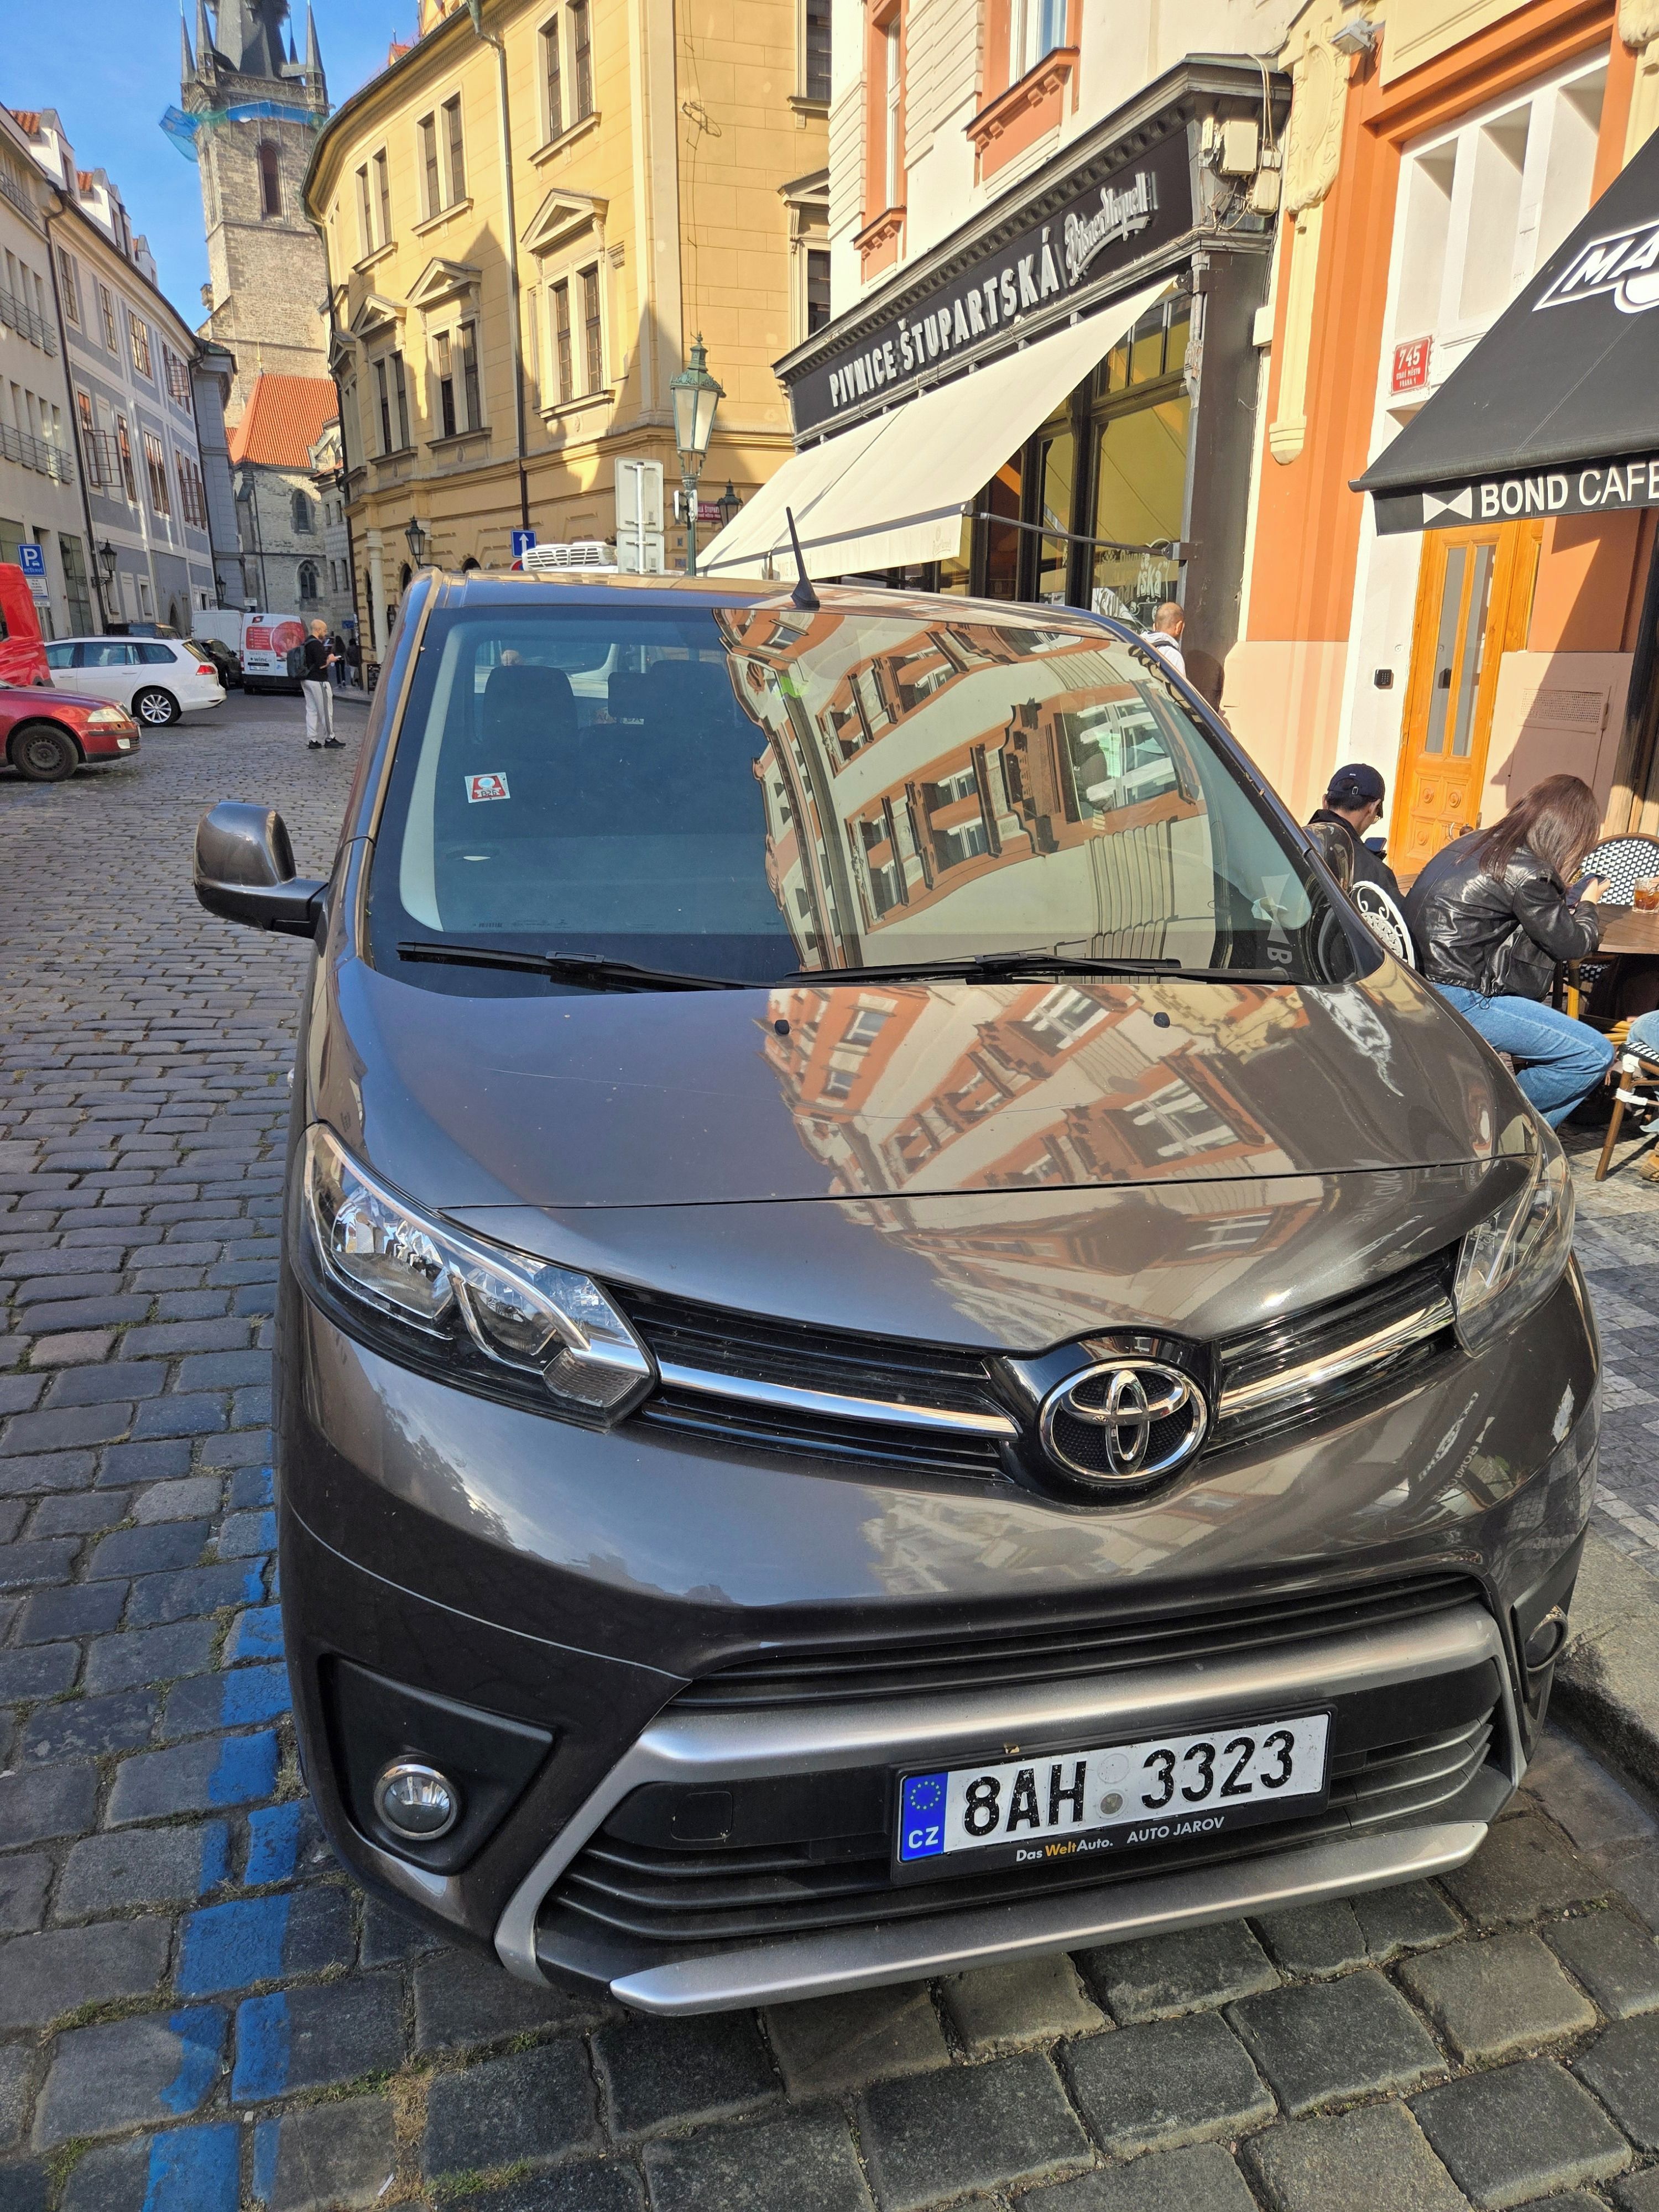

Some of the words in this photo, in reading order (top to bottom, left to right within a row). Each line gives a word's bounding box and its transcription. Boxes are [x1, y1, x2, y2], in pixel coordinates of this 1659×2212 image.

[1065, 213, 1105, 286] Pilsner
[1100, 173, 1148, 241] Urquell
[829, 341, 897, 407] PIVNICE
[898, 227, 1060, 371] ŠTUPARTSKÁ
[1398, 345, 1422, 369] 745
[1407, 367, 1421, 377] MĚSTO
[1480, 474, 1568, 518] BOND
[1579, 460, 1659, 506] CAFE
[23, 548, 38, 567] P
[964, 1760, 1087, 1837] 8AH
[1141, 1730, 1295, 1809] 3323
[908, 1826, 939, 1849] CZ
[1016, 1849, 1043, 1862] Das
[1045, 1839, 1114, 1857] WeltAuto.
[1126, 1825, 1170, 1844] AUTO
[1173, 1816, 1225, 1836] JAROV
